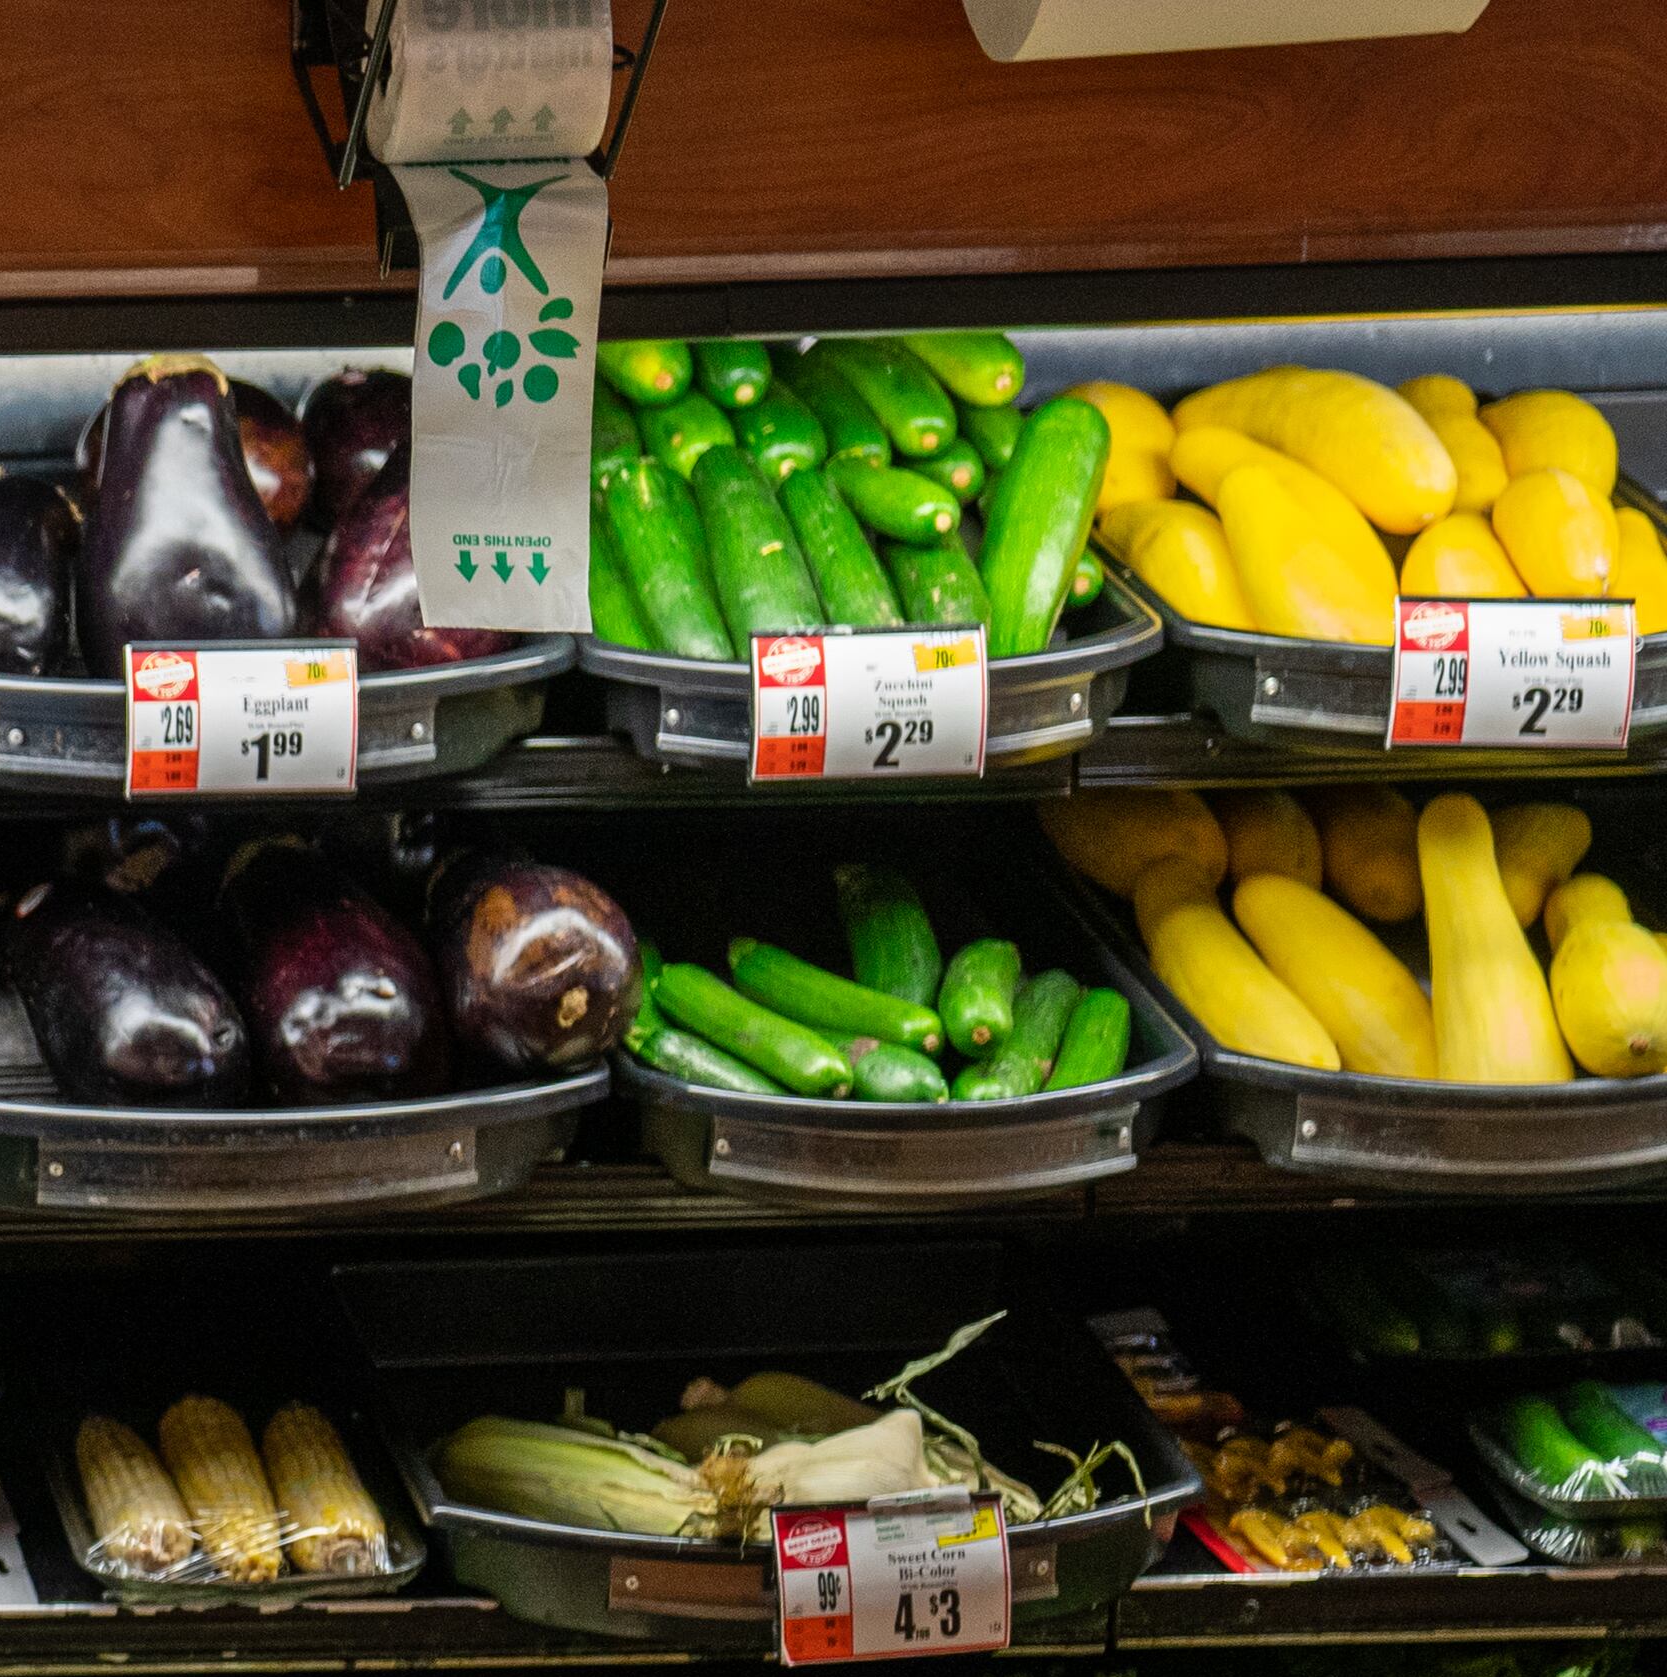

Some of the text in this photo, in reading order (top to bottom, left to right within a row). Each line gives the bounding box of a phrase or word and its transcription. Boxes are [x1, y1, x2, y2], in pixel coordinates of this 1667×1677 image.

[452, 534, 551, 548] OPEN THIS END
[1499, 649, 1612, 673] Yellow Squash
[875, 678, 933, 692] Zucchini
[244, 696, 309, 716] Eggplant
[878, 695, 927, 708] Squash
[888, 1549, 965, 1565] Sweet Corn
[899, 1565, 957, 1579] Bi-Color
